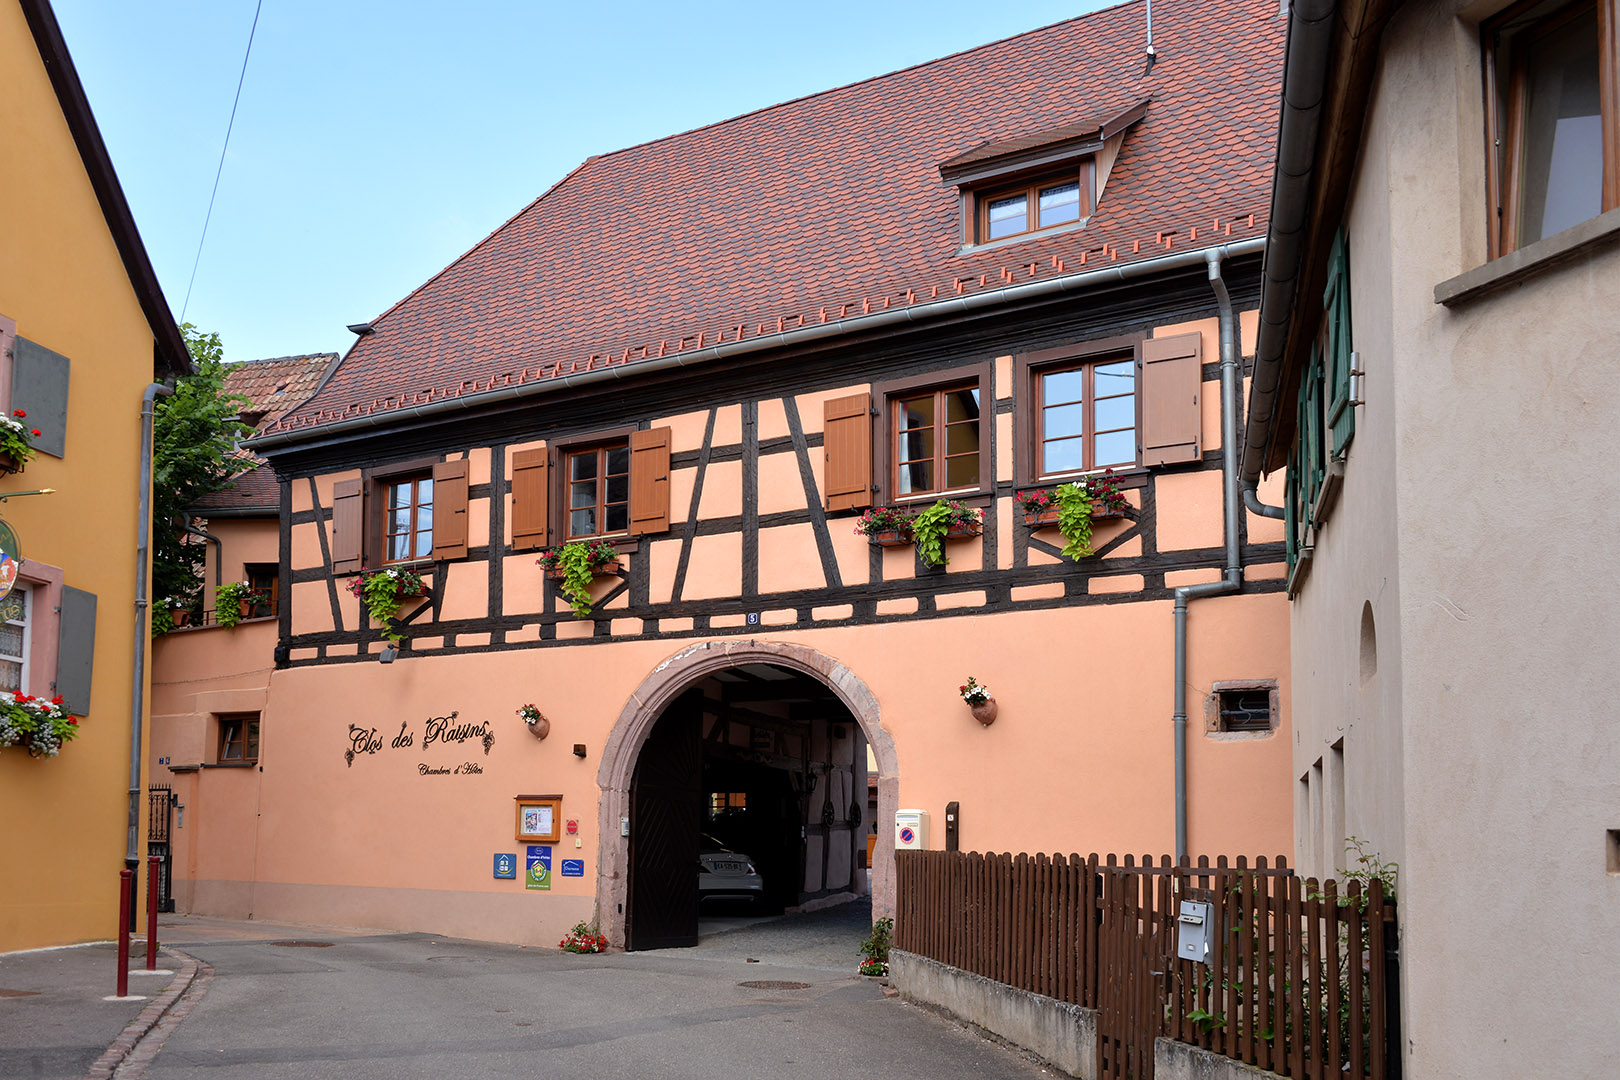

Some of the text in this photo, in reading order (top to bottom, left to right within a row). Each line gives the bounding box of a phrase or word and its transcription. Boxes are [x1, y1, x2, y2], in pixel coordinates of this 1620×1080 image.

[349, 716, 489, 754] Clos des Raisins
[418, 763, 451, 776] Chambres
